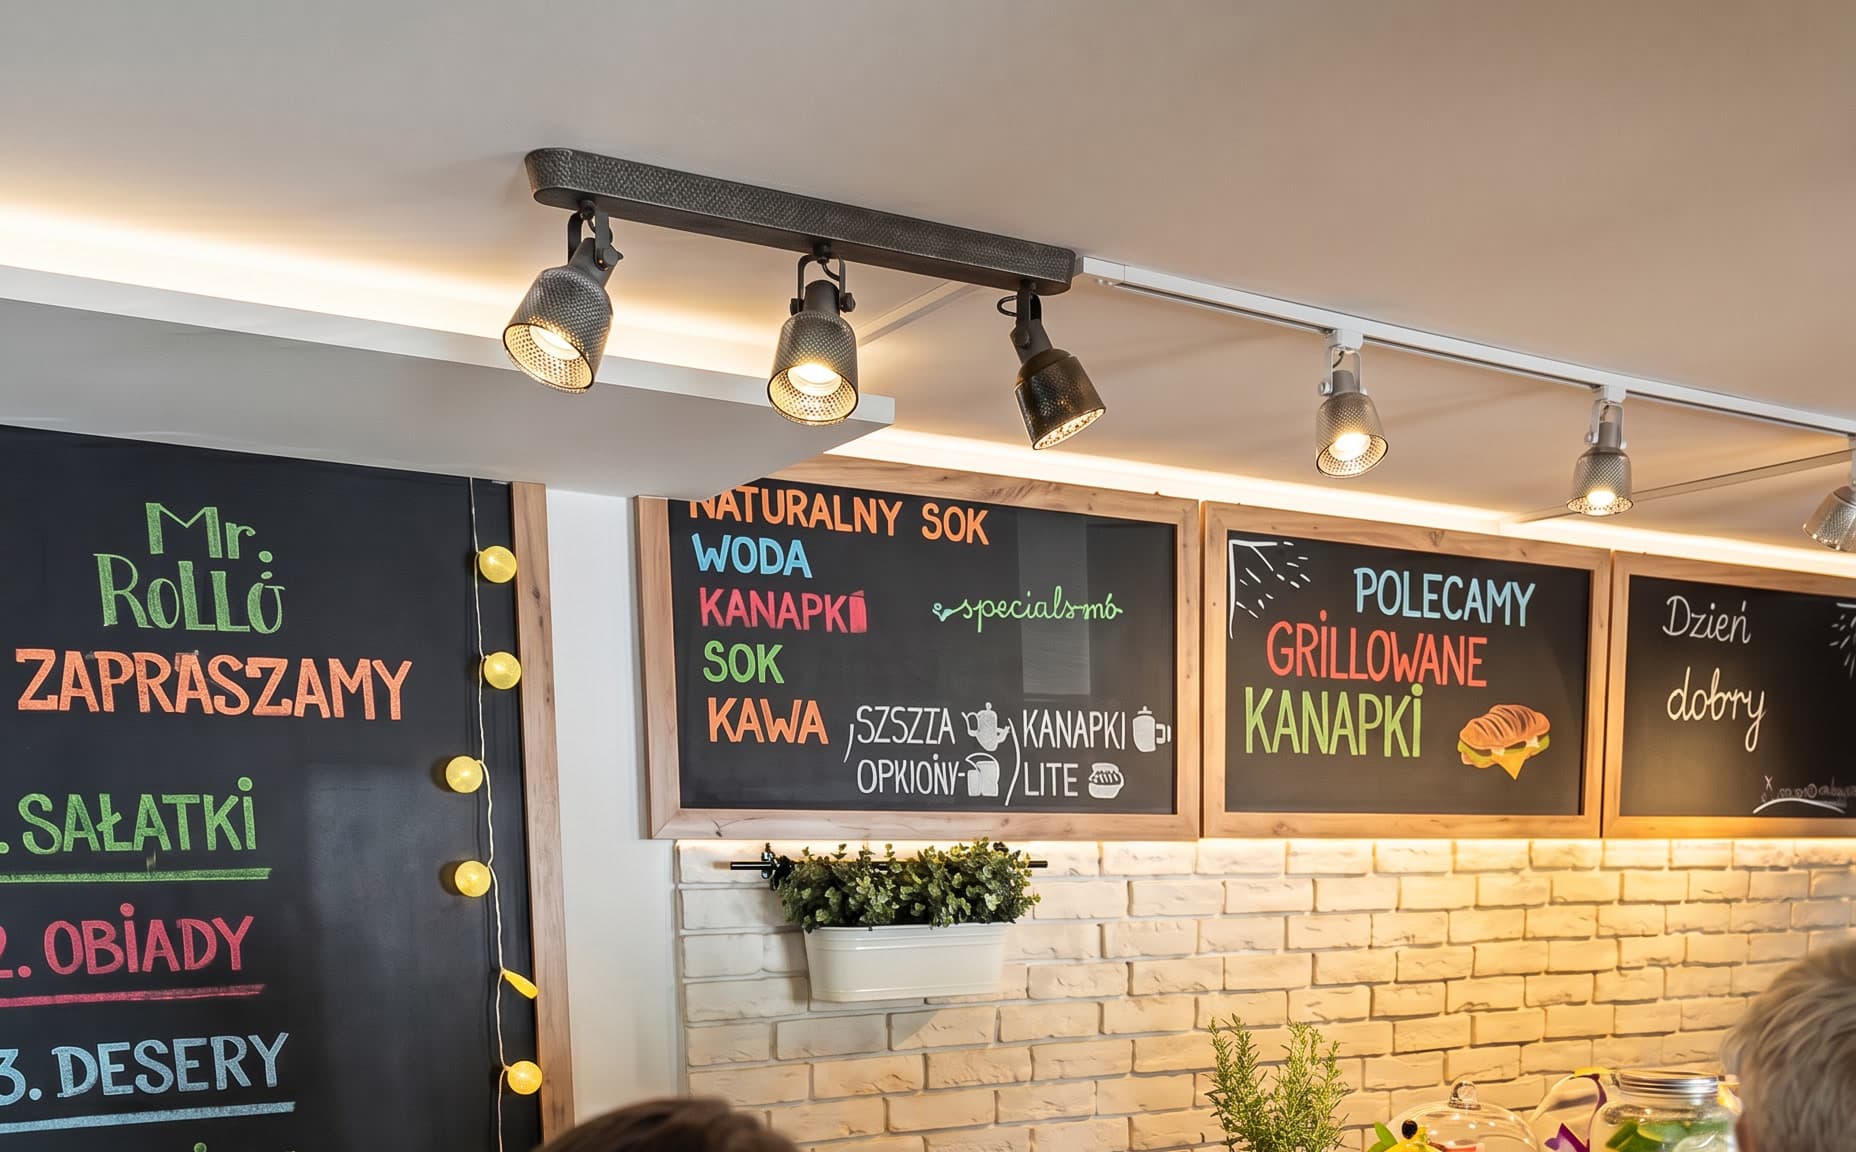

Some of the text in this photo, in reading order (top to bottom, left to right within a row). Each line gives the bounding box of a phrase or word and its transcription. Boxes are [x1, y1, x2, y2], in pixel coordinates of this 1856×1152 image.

[146, 502, 273, 563] Mr.
[921, 502, 991, 546] SOK
[691, 532, 813, 578] WODA
[1353, 567, 1536, 627] POLECAMY
[1662, 595, 1752, 644] Dzień
[15, 648, 413, 721] ZAPRASZAMY
[703, 640, 785, 684] SOK
[707, 696, 829, 745] KAWA
[1022, 709, 1126, 750] KANAPKI
[1666, 666, 1766, 752] dobry
[1023, 761, 1079, 797] LITE
[51, 1032, 289, 1098] DESERY
